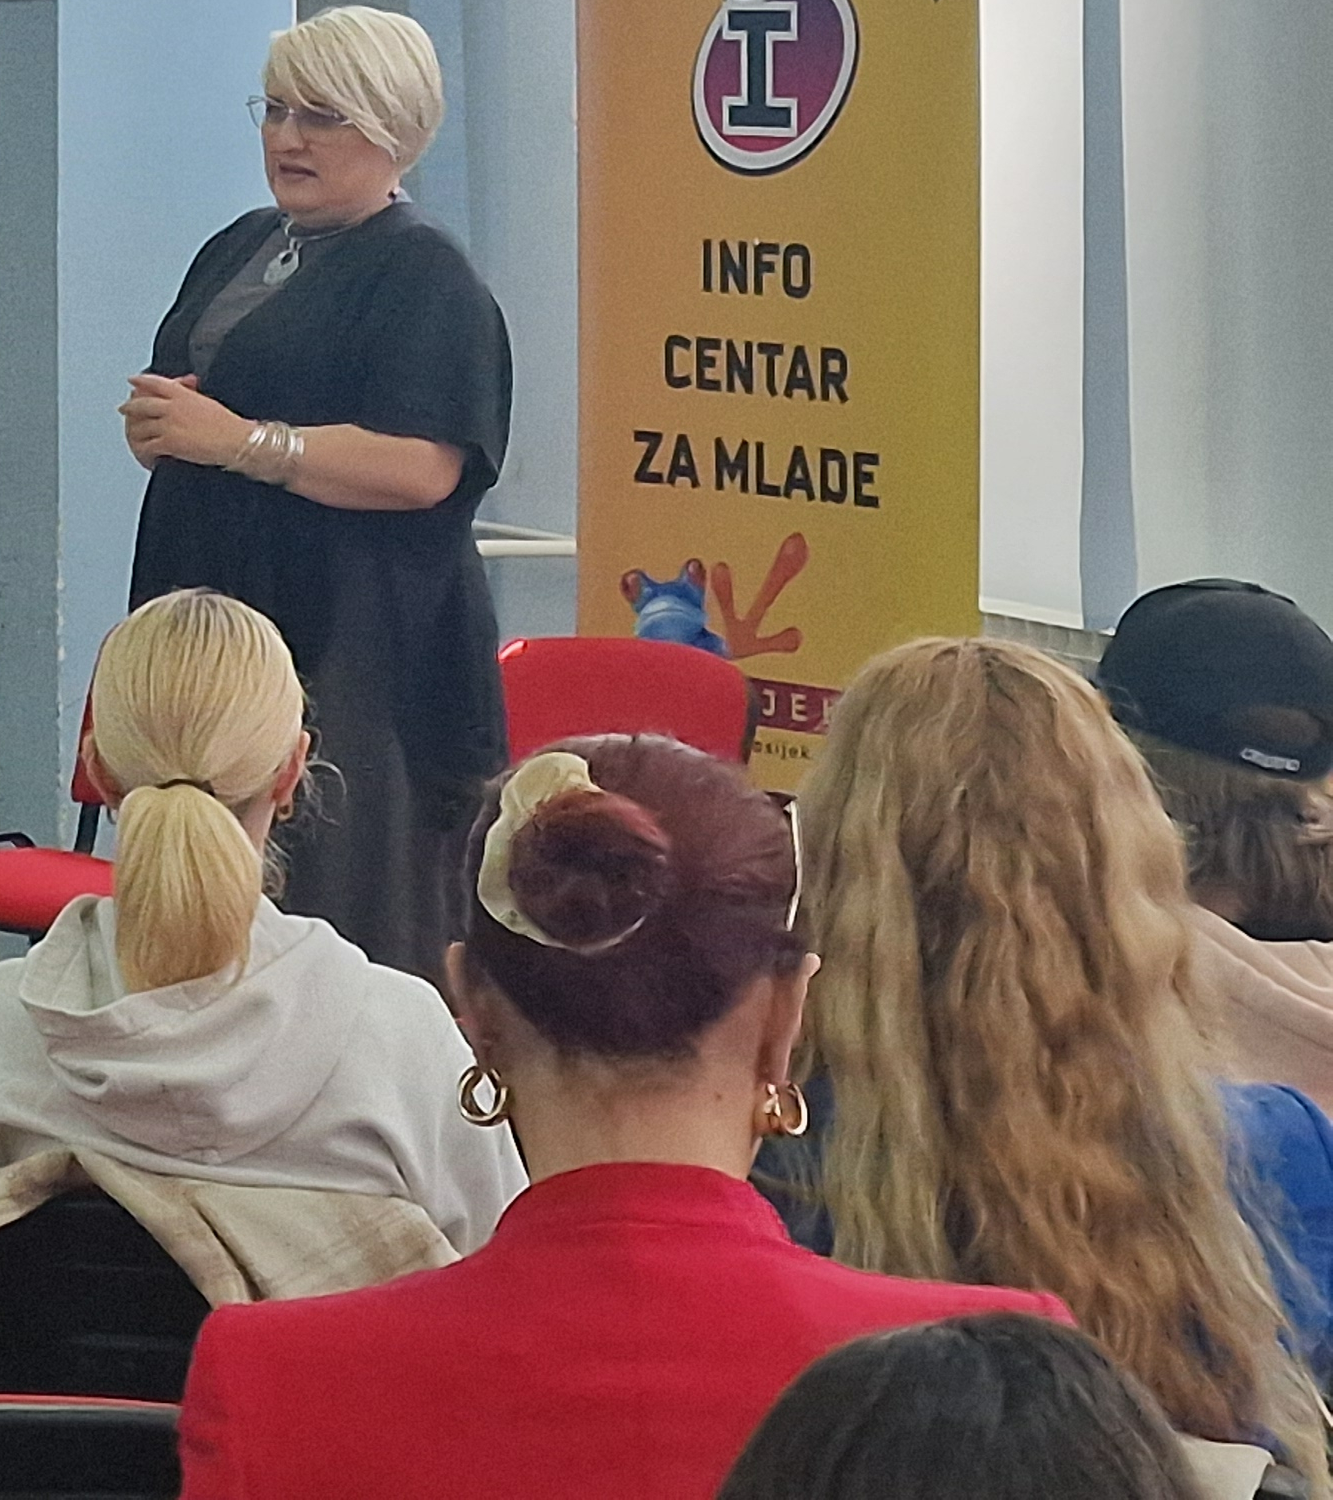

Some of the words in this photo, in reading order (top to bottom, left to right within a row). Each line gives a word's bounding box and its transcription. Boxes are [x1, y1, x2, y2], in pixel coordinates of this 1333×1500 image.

[700, 238, 812, 299] INFO
[663, 334, 850, 404] CENTAR
[633, 430, 700, 489] ZA
[714, 437, 881, 509] MLADE
